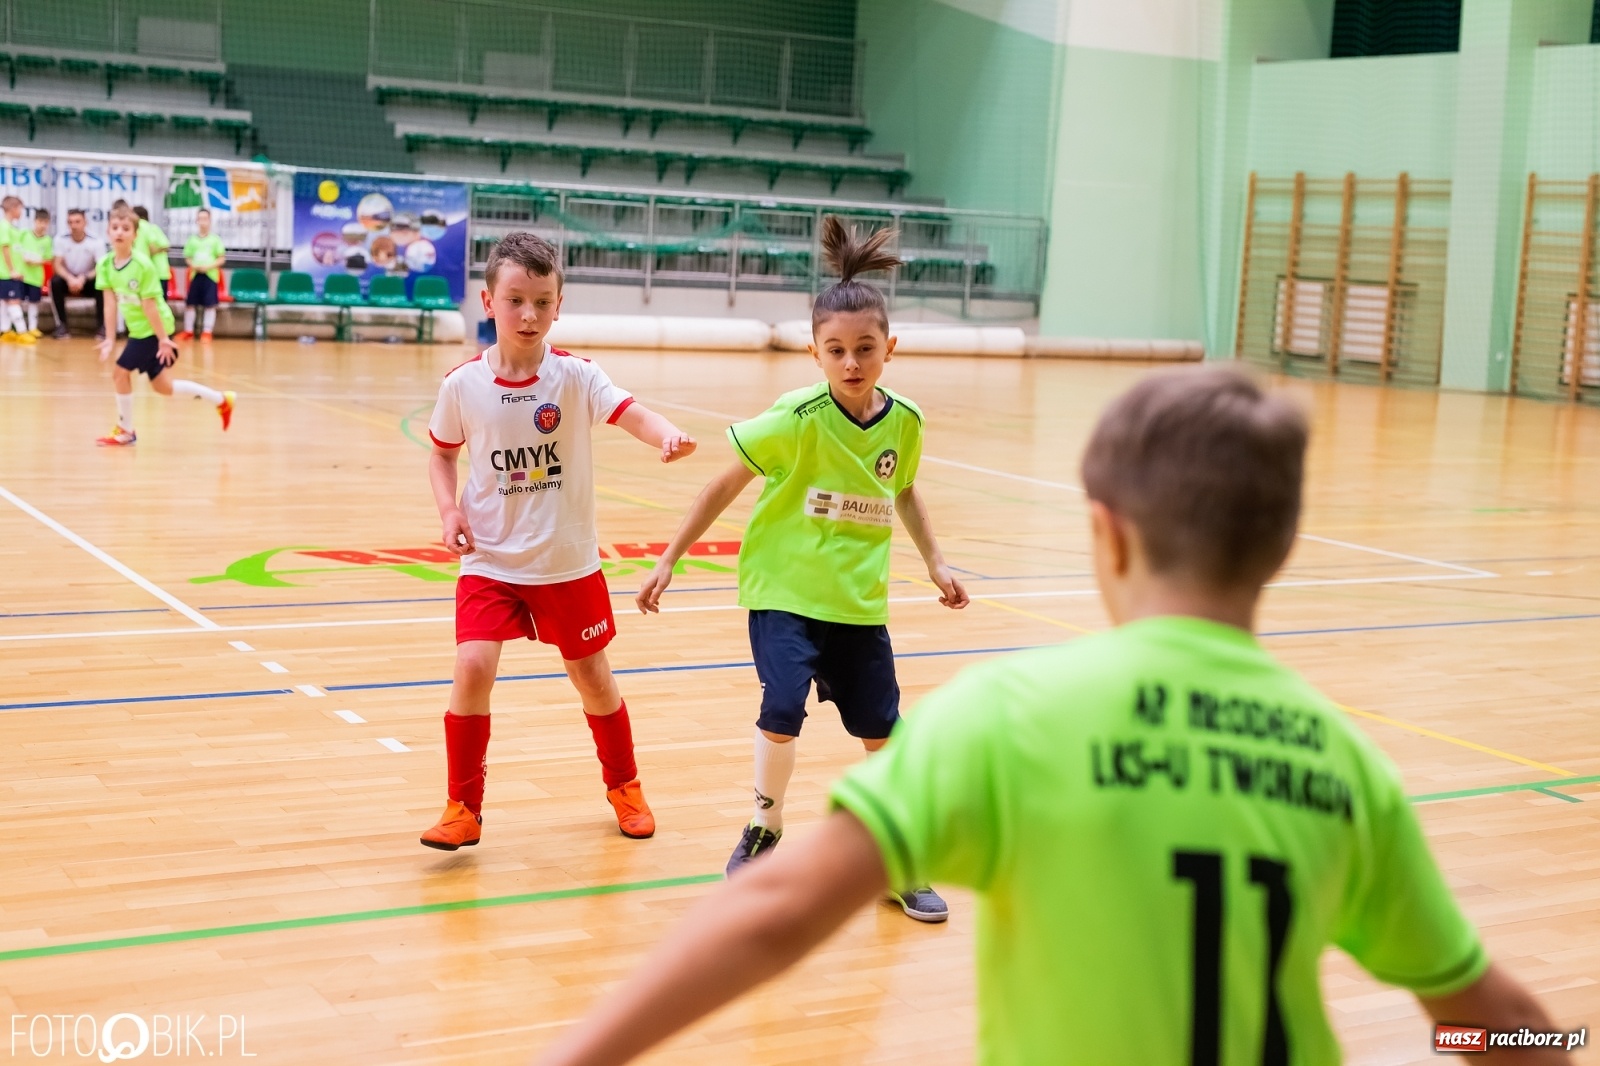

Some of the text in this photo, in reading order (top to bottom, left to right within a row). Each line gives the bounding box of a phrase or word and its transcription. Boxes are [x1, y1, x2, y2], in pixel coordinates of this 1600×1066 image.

[490, 441, 561, 470] CMYK
[525, 479, 561, 494] reklamy
[841, 500, 893, 516] BAUMAG
[581, 618, 609, 641] CMYK
[1171, 851, 1294, 1066] 11
